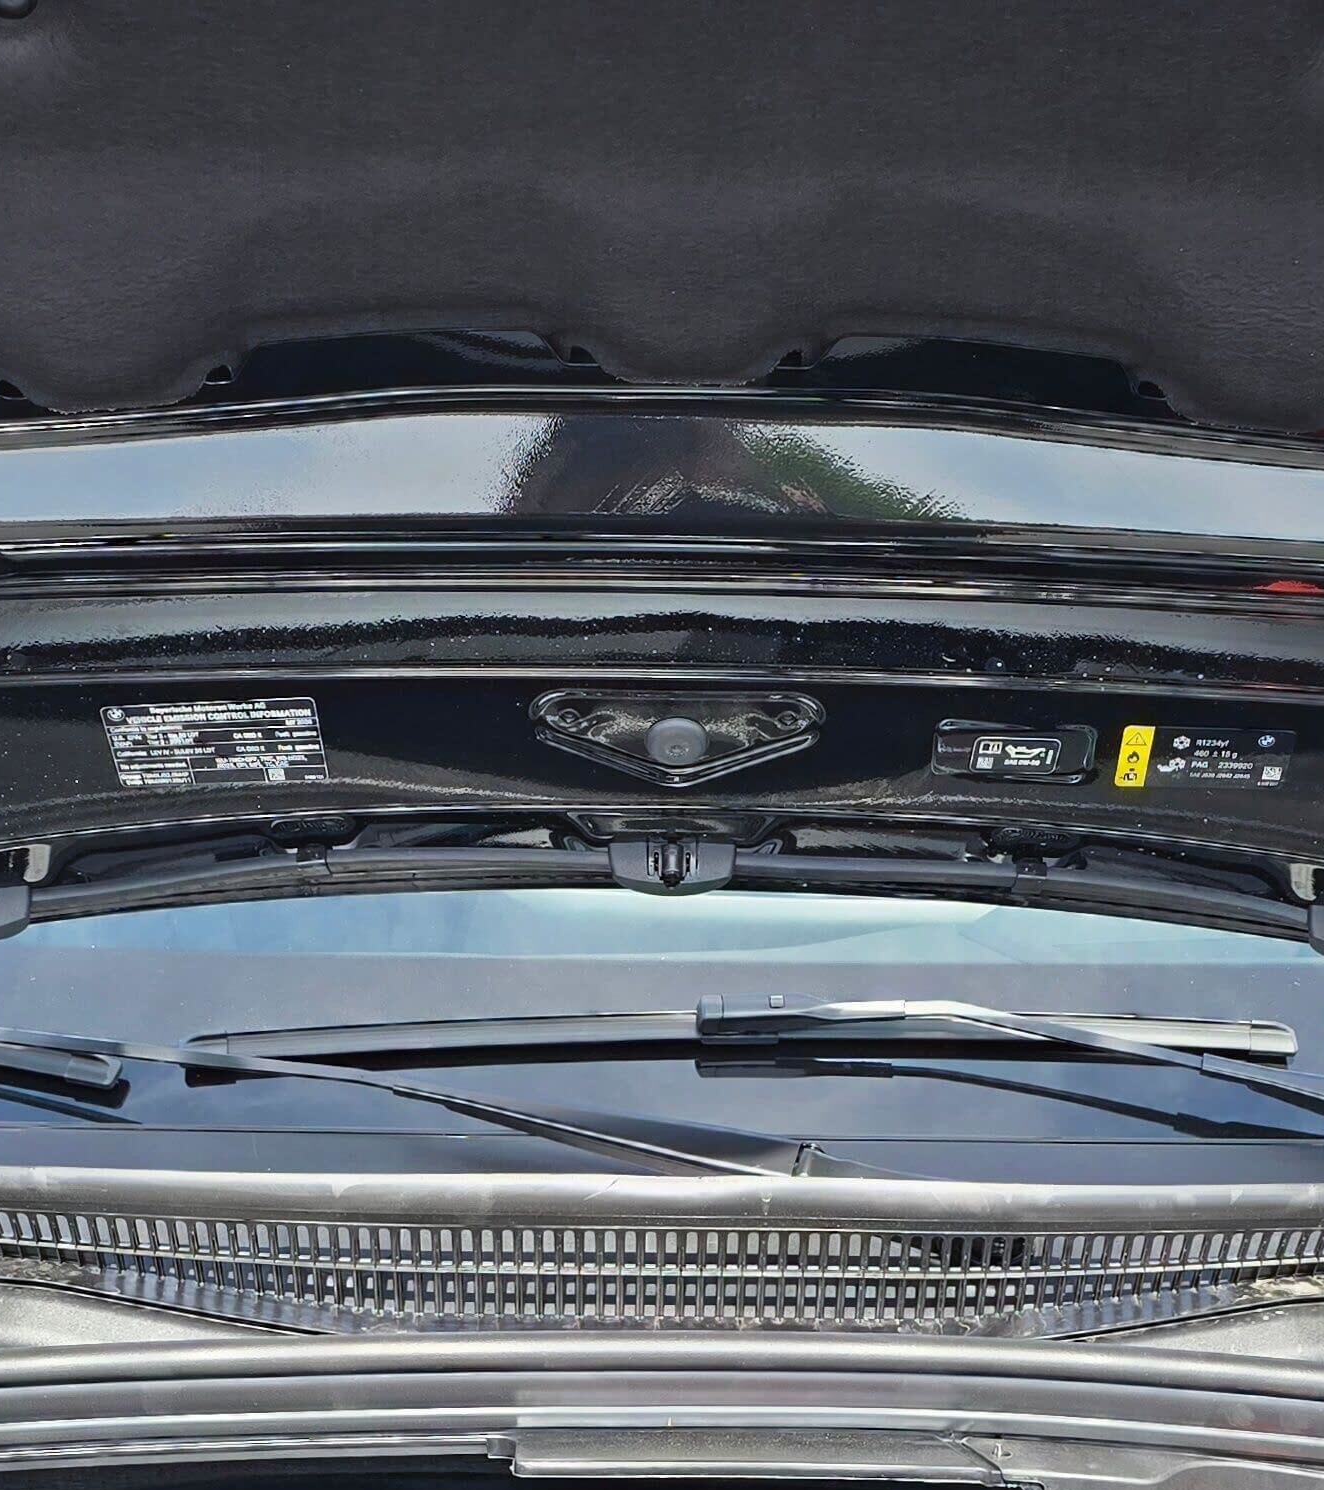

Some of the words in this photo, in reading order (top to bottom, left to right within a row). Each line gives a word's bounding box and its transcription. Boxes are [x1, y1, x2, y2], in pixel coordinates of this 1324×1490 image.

[254, 702, 266, 710] AG
[126, 716, 162, 724] VEHICLE
[163, 714, 206, 722] EMISSION
[207, 712, 249, 720] CONTROL
[250, 709, 312, 718] INFORMATION
[1195, 740, 1229, 748] R1234yf
